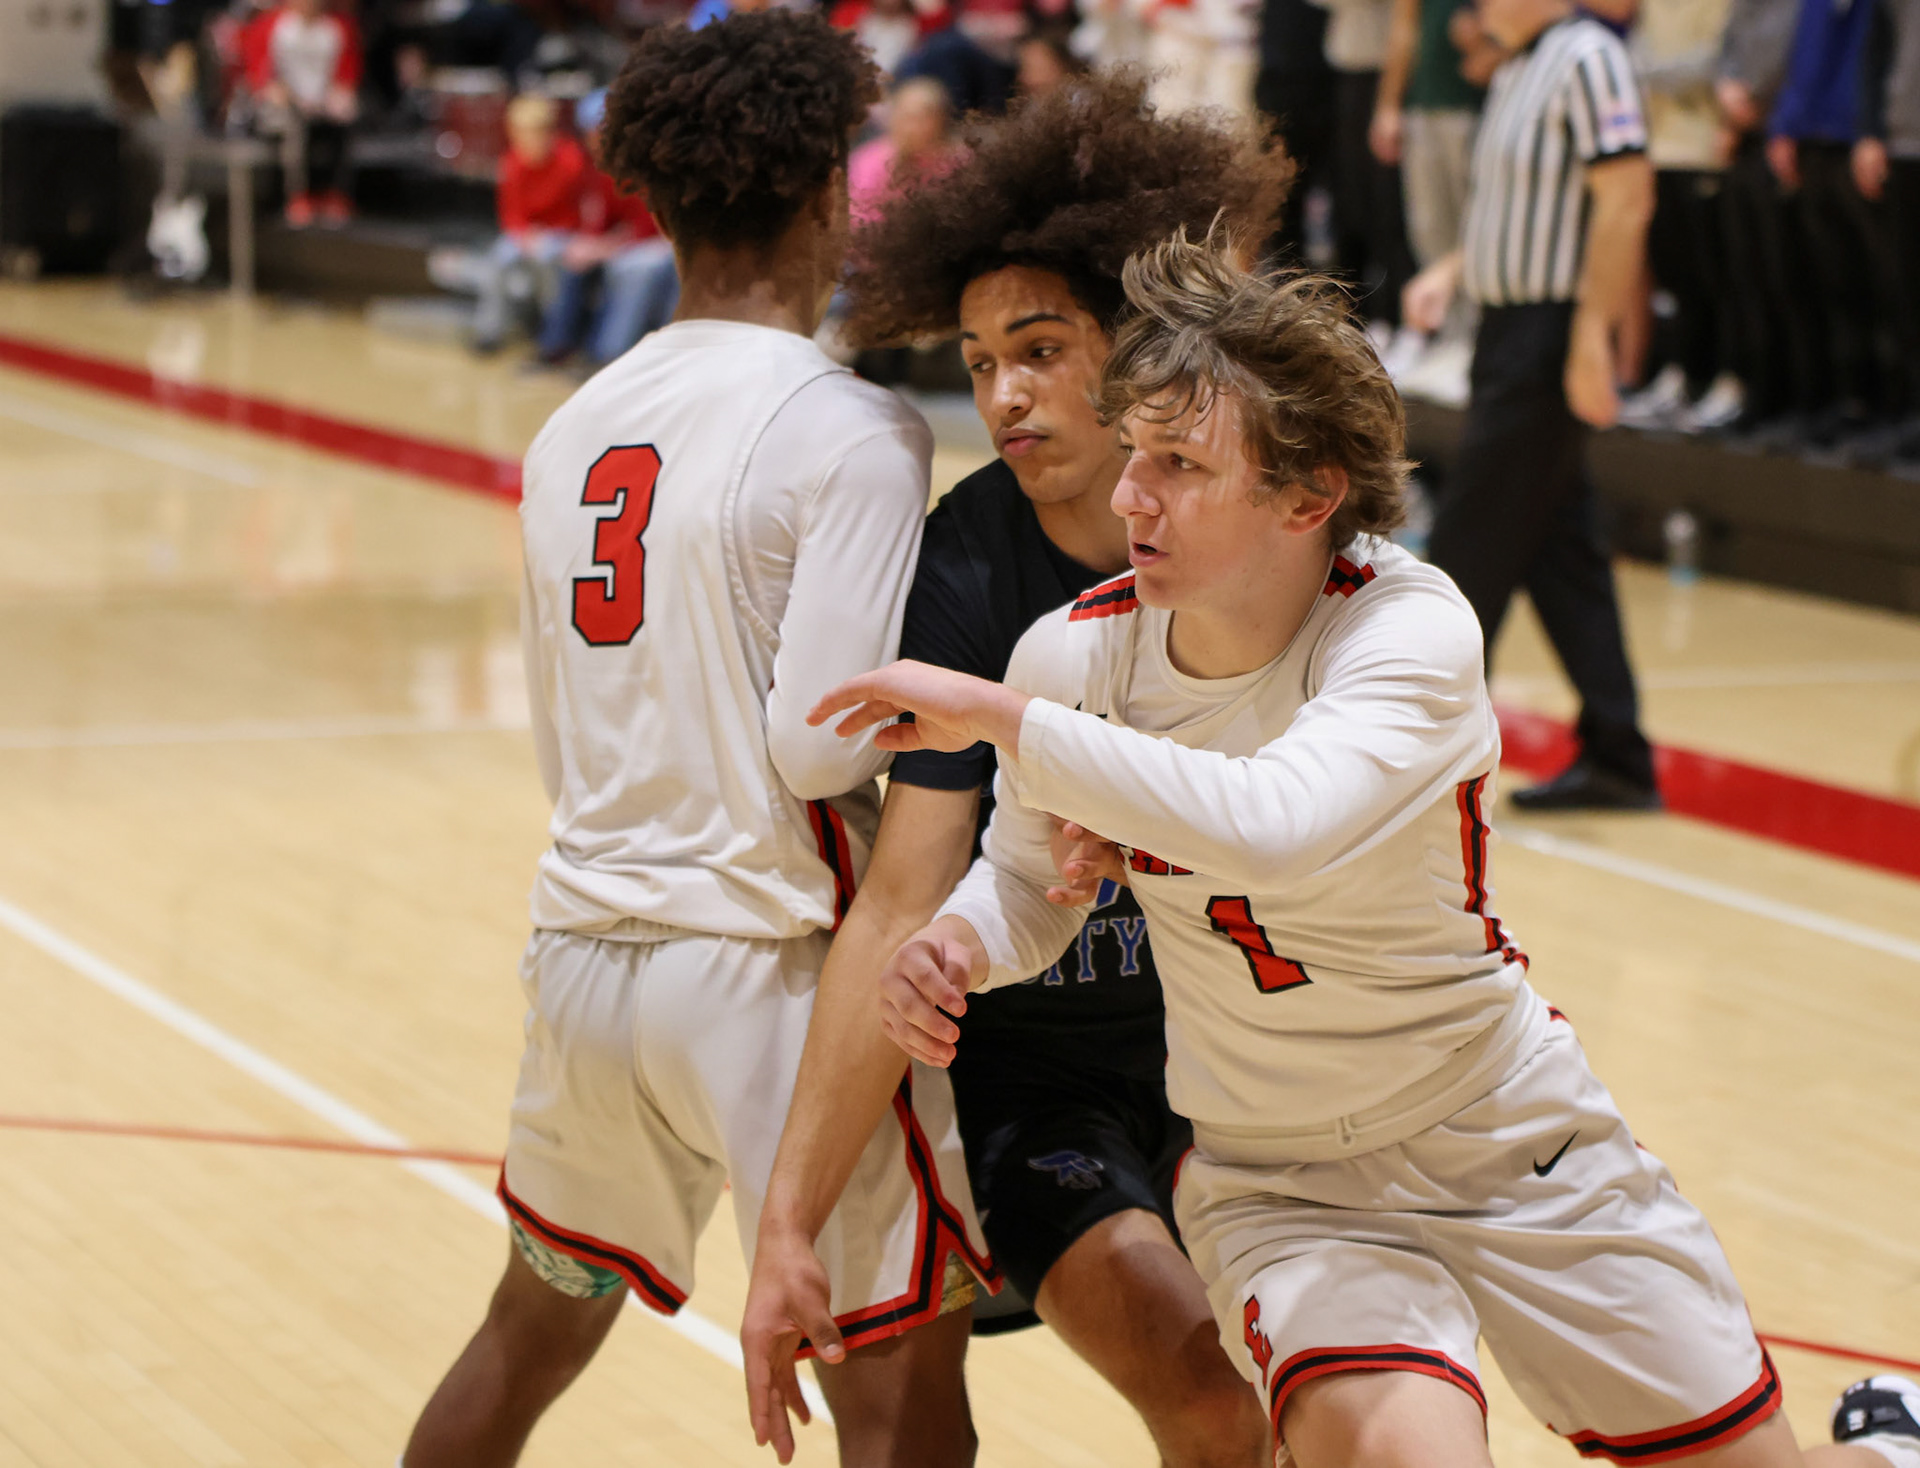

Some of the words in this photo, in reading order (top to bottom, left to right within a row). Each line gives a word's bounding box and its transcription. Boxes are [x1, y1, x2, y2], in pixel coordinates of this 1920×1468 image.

[572, 443, 662, 647] 3
[1018, 916, 1147, 986] TY
[1205, 895, 1313, 994] 1
